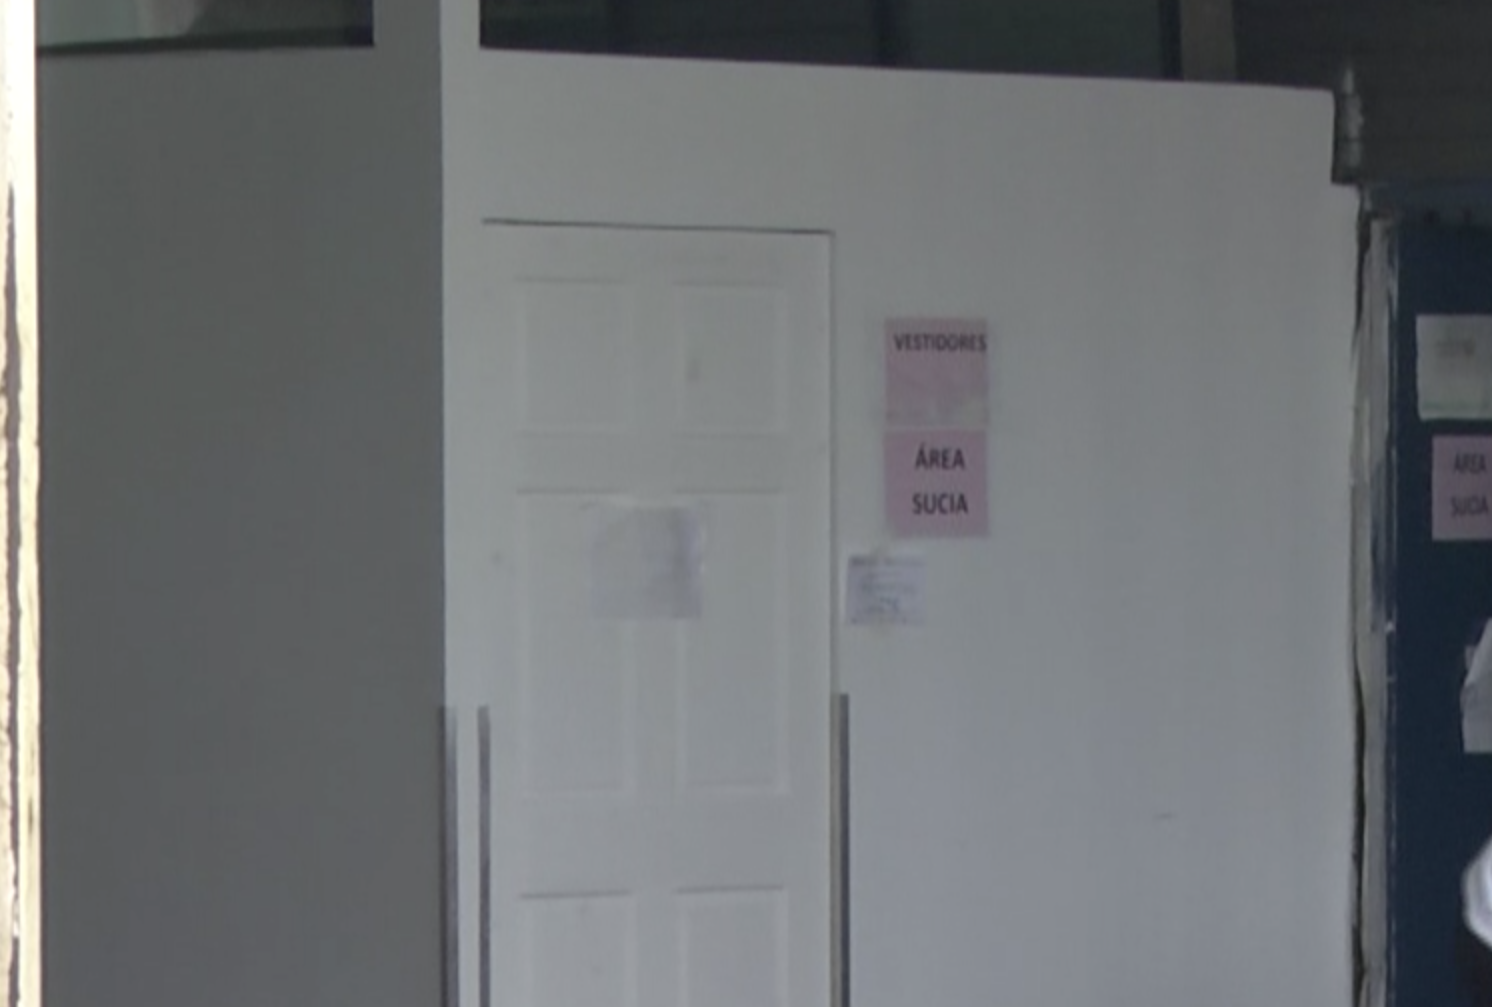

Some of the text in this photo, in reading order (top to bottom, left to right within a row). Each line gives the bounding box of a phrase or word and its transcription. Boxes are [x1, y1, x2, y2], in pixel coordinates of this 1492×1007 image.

[893, 333, 988, 352] VESTIDORES
[914, 442, 966, 471] ÁREA
[912, 492, 969, 515] SUCIA
[1450, 494, 1489, 517] SUCIA
